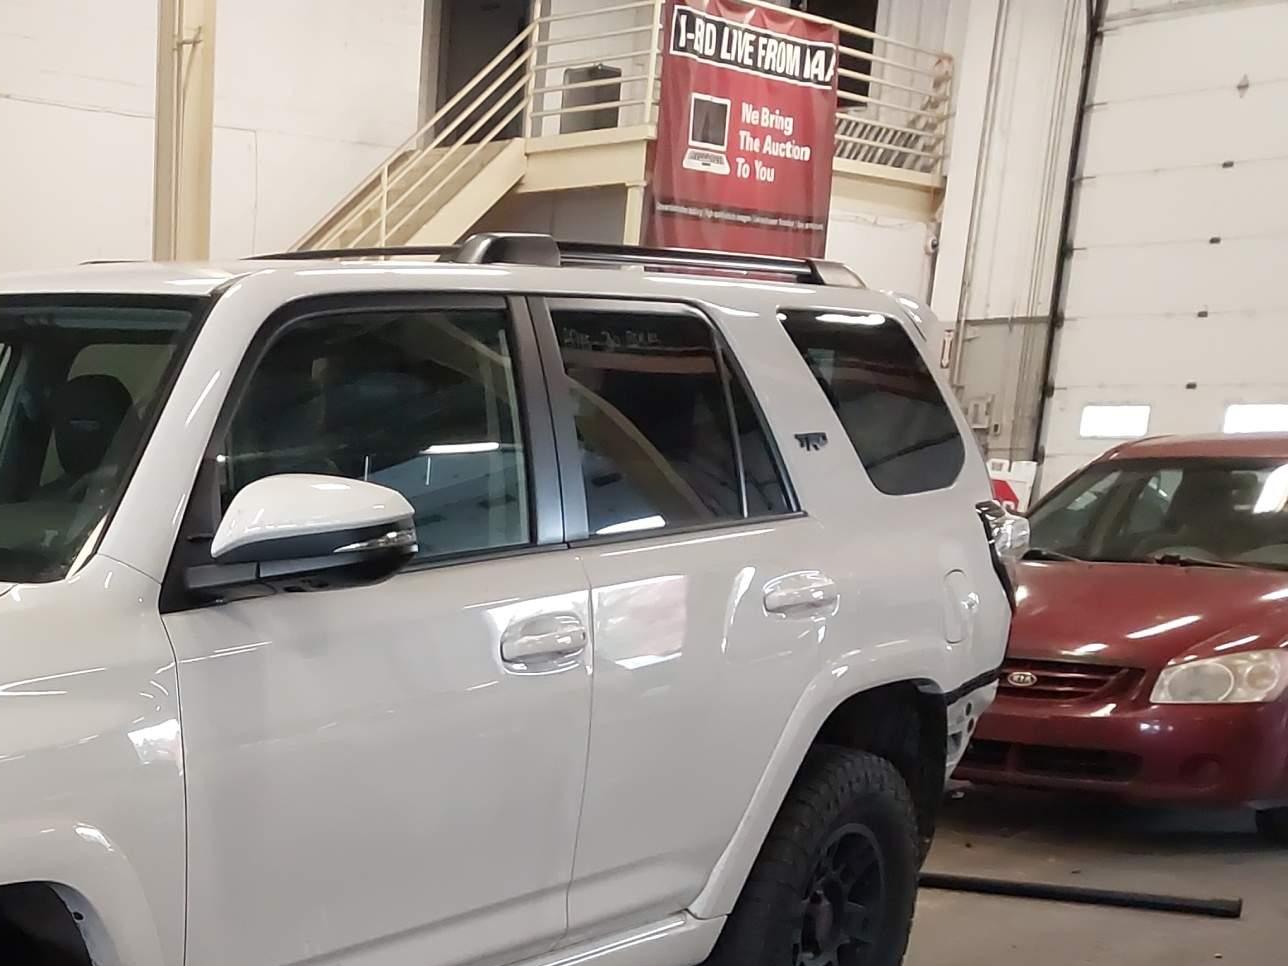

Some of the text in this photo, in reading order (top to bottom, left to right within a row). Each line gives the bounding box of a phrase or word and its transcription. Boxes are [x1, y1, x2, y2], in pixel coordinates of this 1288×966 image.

[720, 26, 757, 67] LIVE
[757, 36, 801, 77] FROM
[760, 106, 794, 136] Bring
[739, 130, 812, 162] The Auction
[735, 157, 776, 183] To You
